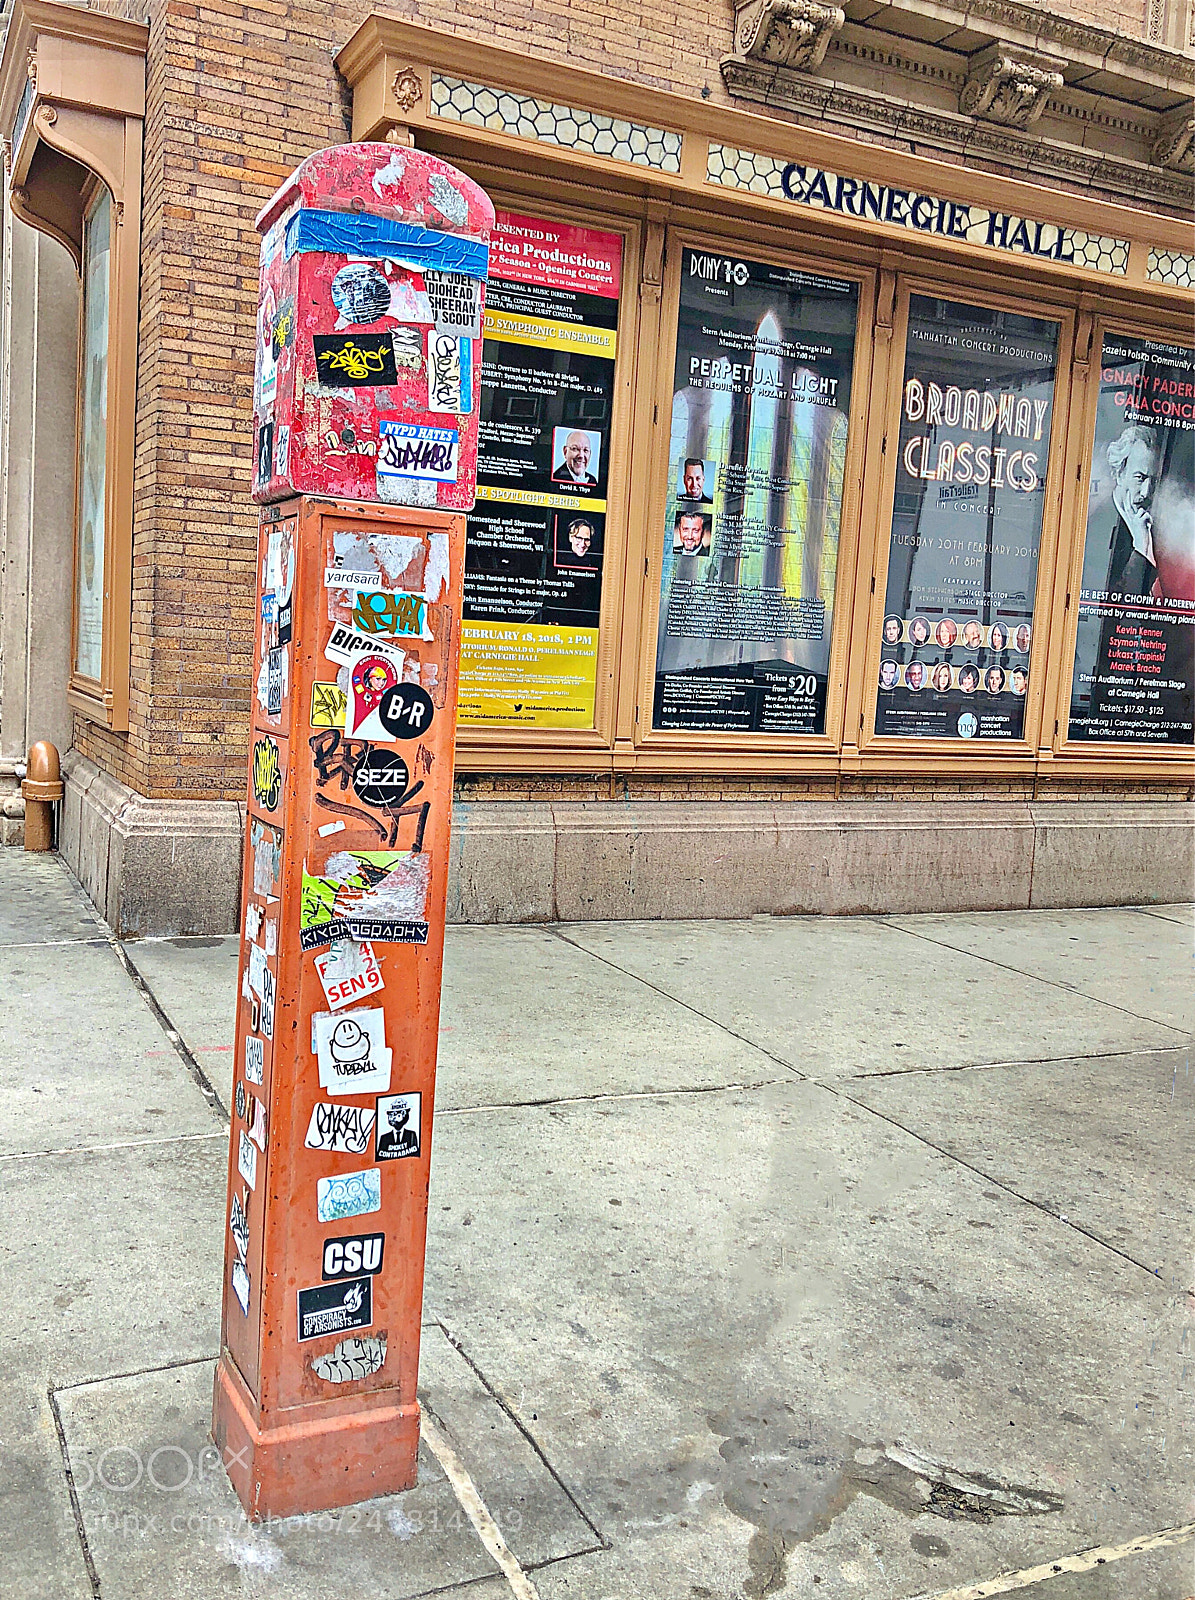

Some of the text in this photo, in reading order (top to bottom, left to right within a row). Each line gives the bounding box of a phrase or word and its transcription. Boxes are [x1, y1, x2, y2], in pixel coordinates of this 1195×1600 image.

[780, 163, 1075, 262] CARNEGIE HALL
[493, 223, 560, 242] ESENTED BY
[523, 243, 611, 271] Productions
[499, 255, 613, 284] Season Opening Concert
[448, 273, 473, 287] JOEL
[425, 282, 472, 300] DIOHEAD
[502, 283, 576, 300] GENERAL MUSIC DIRECTOR
[705, 286, 729, 296] Presents
[514, 297, 545, 308] CONDUCTOR
[442, 312, 476, 327] SCOUT
[553, 311, 583, 320] CONDUCTOR
[496, 318, 556, 337] SYMPHONIC
[558, 330, 610, 347] ENSEMBLE
[702, 326, 718, 337] Stern
[796, 341, 819, 354] Carnegie
[912, 329, 1053, 363] MANHATTAN CONCERT PRODUCTIONS
[1145, 341, 1187, 357] Presented by
[1151, 354, 1191, 371] Community
[504, 373, 532, 384] Symphony
[690, 357, 838, 396] PERPETUAL LIGHT
[529, 386, 557, 396] Conductor
[689, 377, 702, 387] THE
[706, 379, 742, 393] REQUIEMS
[745, 386, 755, 395] OF
[758, 388, 788, 400] MOZART
[790, 393, 805, 402] AND
[1153, 378, 1195, 397] PADER
[1114, 391, 1148, 411] GALA
[905, 378, 1049, 441] BROADWAY
[1124, 410, 1180, 428] February 21 2018
[385, 423, 453, 441] NYPD HATES
[903, 436, 1039, 492] CLASSICS
[491, 490, 580, 508] SPOTLIGHT SERIES
[936, 501, 1002, 516] IN CONCERT
[467, 515, 546, 529] Homestead and Shorewood
[489, 525, 524, 535] High School
[477, 532, 535, 544] Chamber Orchestra,
[892, 534, 1038, 558] TUESDAY 20TH FEBRUARY 2018
[950, 555, 983, 567] AT 8PM
[326, 572, 380, 585] yardsard
[944, 578, 981, 586] FEATURING
[1092, 591, 1154, 605] BEST OF CHOPIN
[508, 607, 536, 615] Conductor
[1079, 606, 1176, 624] erformed by award-winning
[522, 633, 536, 643] 18,
[538, 634, 564, 644] 2018,
[575, 635, 592, 645] PM
[1116, 625, 1163, 637] Kevin Kenner
[1109, 637, 1167, 651] Szymon Nehring
[474, 651, 516, 661] CARNEGIE
[518, 654, 539, 662] HALL
[1110, 661, 1161, 673] Marek Bracha
[765, 673, 816, 695] Tickets $20
[772, 684, 786, 692] from
[1079, 674, 1185, 690] Stern Auditorium Perelman Stage
[1116, 689, 1160, 699] Carnegie Hall
[1099, 703, 1122, 713] Tickets:
[1149, 707, 1164, 715] $125
[356, 768, 406, 786] SEZE
[328, 974, 366, 1003] SEN
[324, 1238, 383, 1275] CSU
[303, 1310, 347, 1326] CONSPIRACY
[304, 1326, 313, 1336] OF
